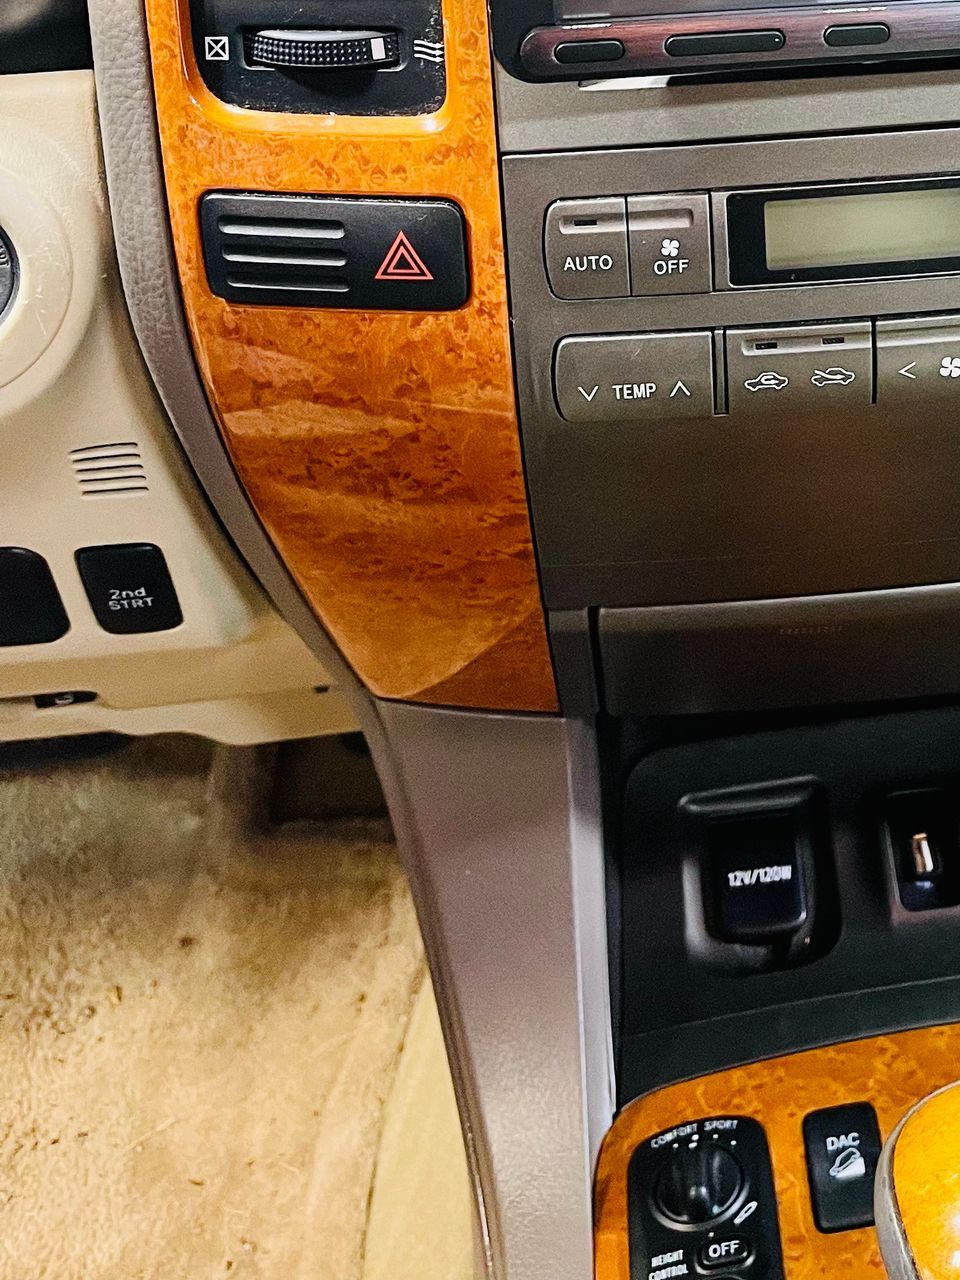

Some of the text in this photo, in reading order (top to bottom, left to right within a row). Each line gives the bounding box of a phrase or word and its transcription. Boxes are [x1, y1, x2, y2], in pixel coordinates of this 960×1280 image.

[563, 255, 613, 272] AUTO
[653, 259, 689, 276] OFF
[612, 382, 657, 401] TEMP
[108, 586, 147, 599] 2nd
[108, 597, 154, 610] STRT
[727, 865, 792, 887] 12V/120W
[825, 1132, 861, 1151] DAC
[708, 1240, 740, 1258] OFF
